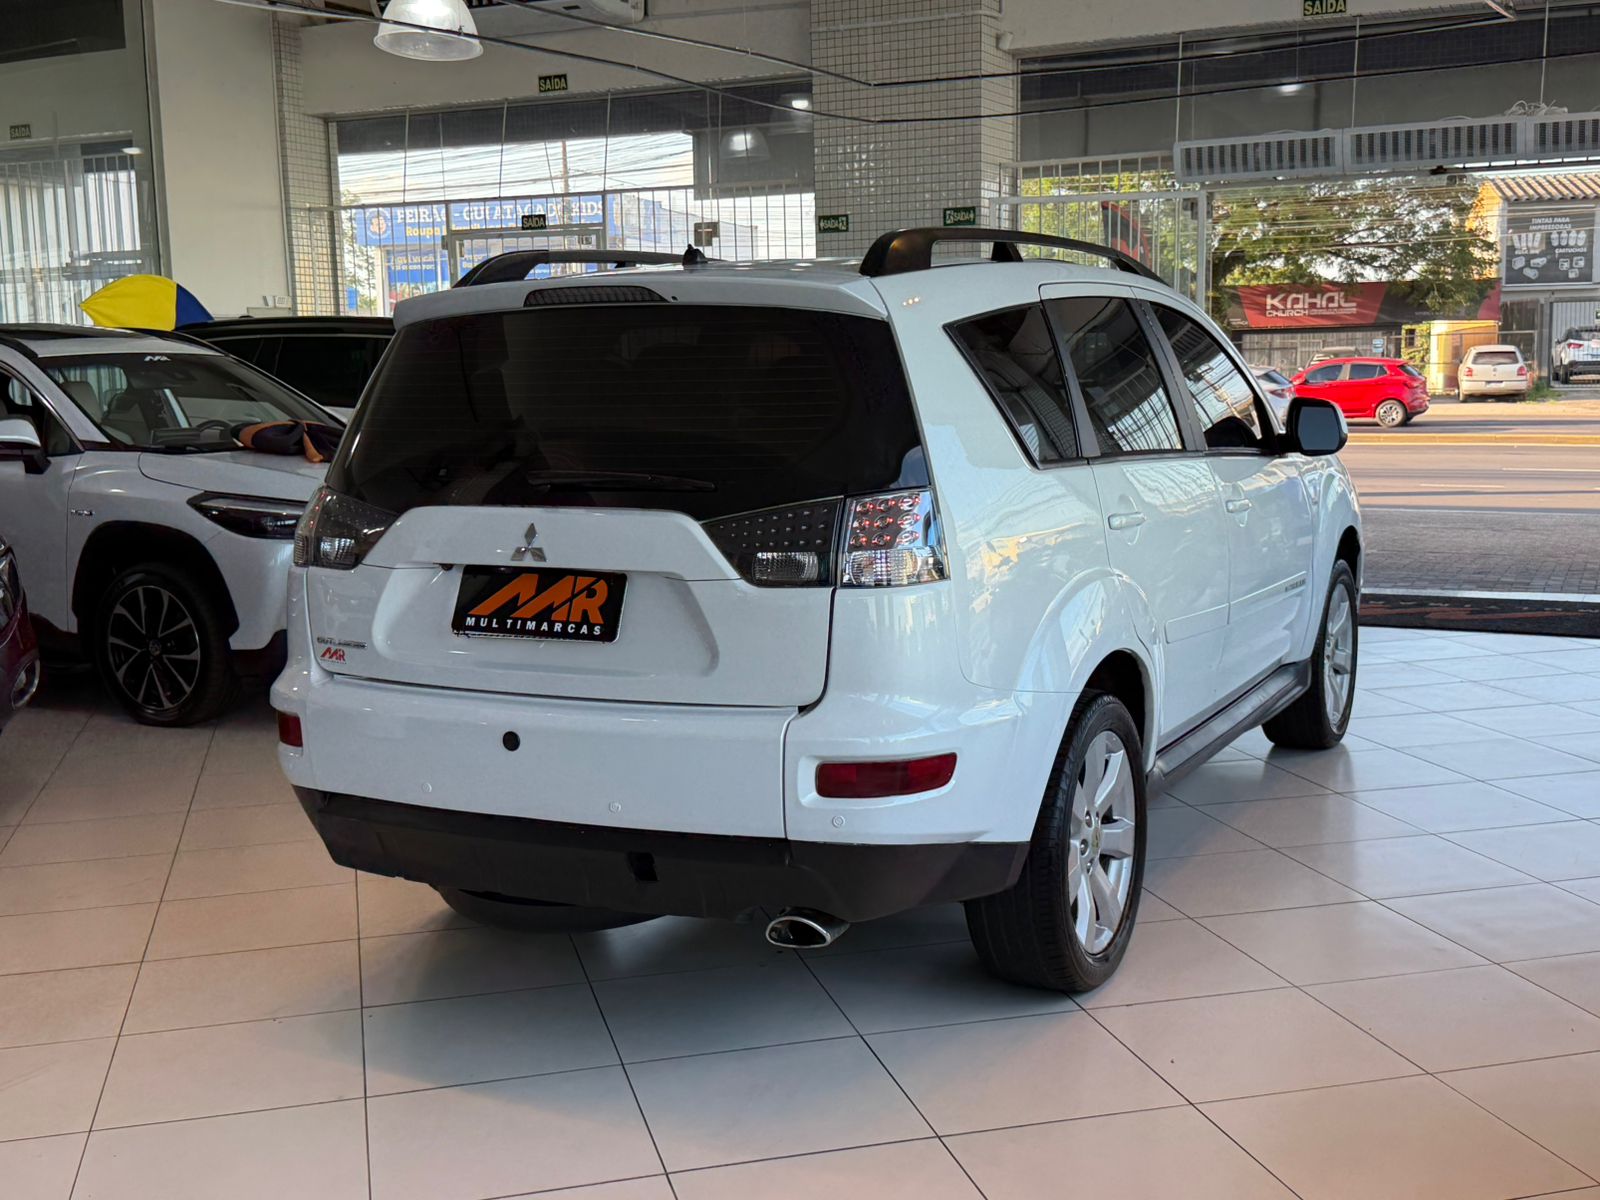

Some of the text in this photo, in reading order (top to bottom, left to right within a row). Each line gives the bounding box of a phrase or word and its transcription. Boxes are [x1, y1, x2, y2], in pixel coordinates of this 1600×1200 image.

[540, 76, 567, 91] SAÍDA
[522, 216, 545, 228] SAÍDA
[1266, 291, 1357, 310] KAHAL
[1266, 308, 1308, 317] CHURCH
[465, 616, 602, 635] MULTIMARCAS
